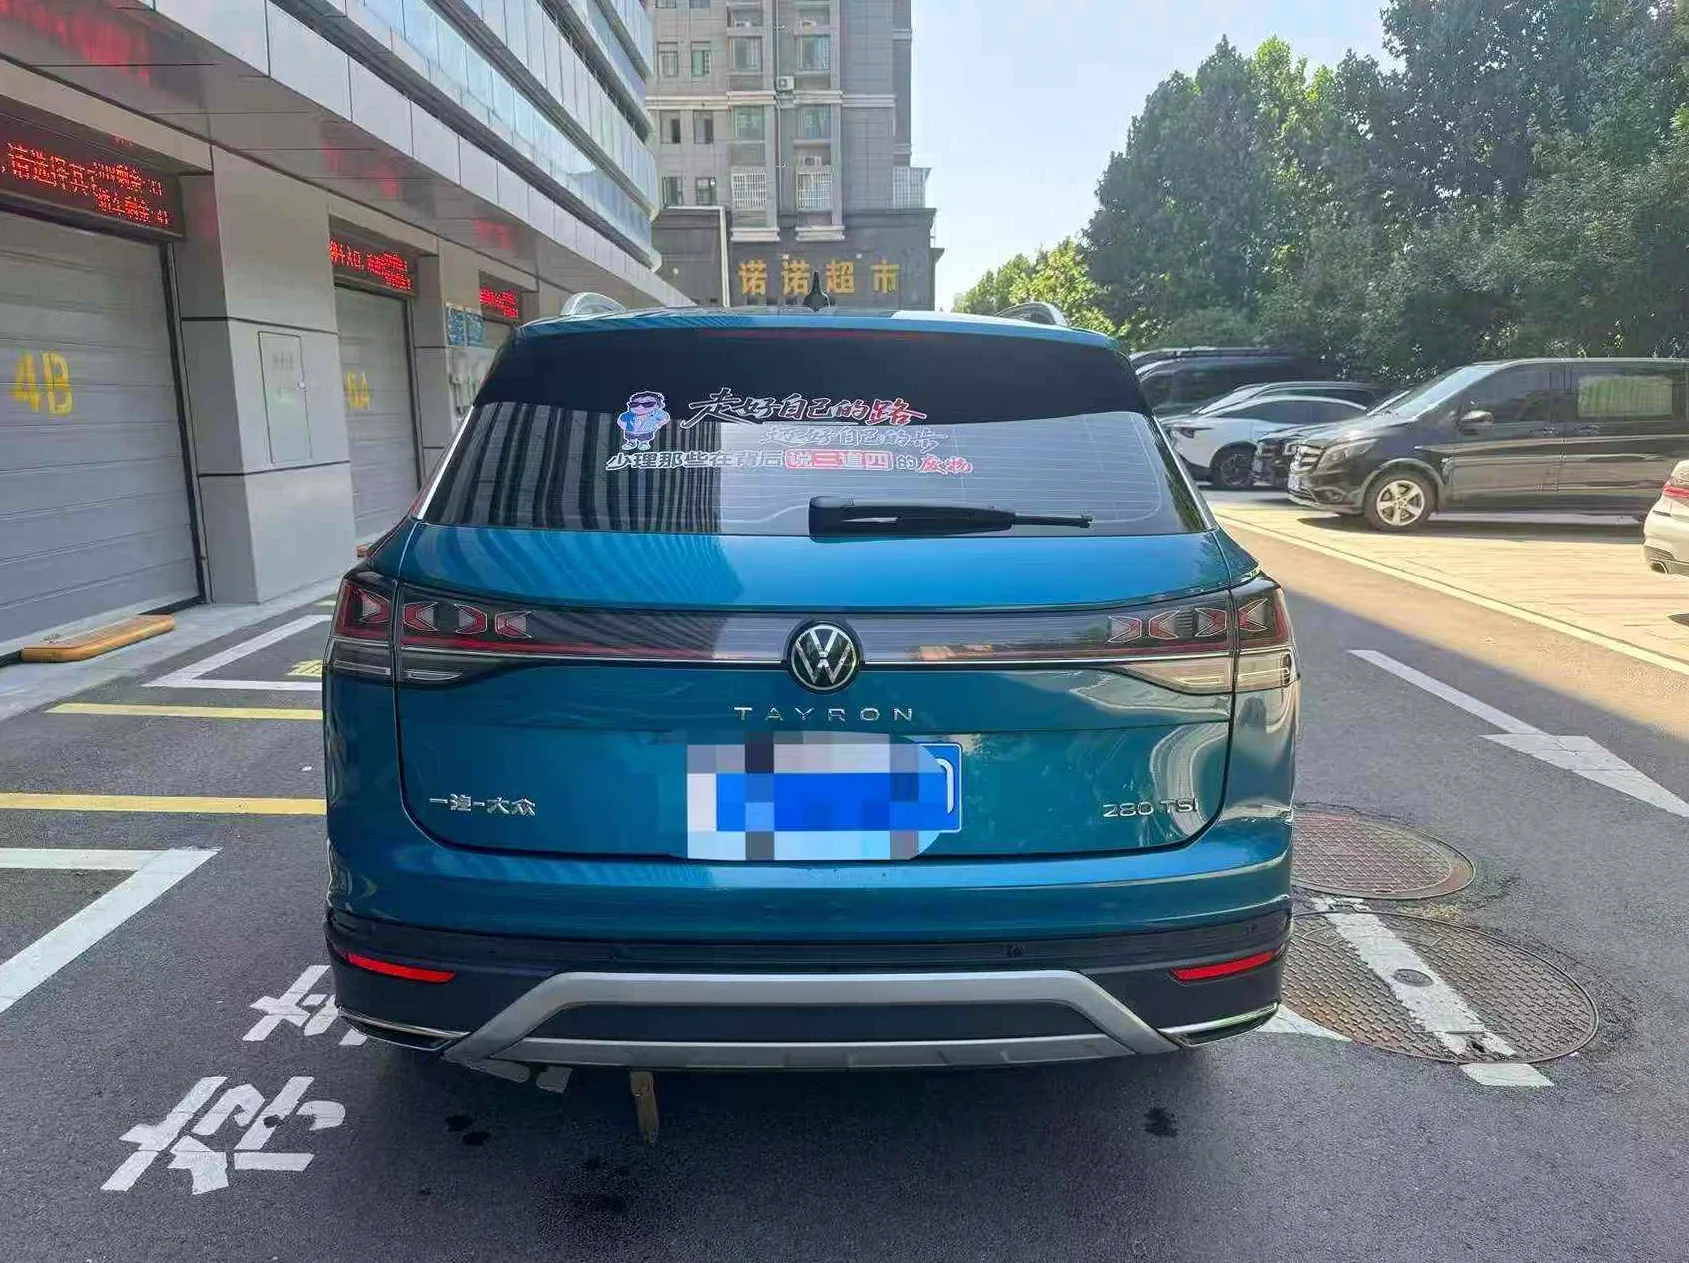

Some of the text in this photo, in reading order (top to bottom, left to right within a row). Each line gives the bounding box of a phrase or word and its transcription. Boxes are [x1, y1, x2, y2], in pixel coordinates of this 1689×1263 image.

[738, 257, 900, 296] 诺诺超市
[14, 353, 73, 414] 4B
[680, 387, 928, 429] 走好自己的路
[733, 704, 913, 721] TAYRON
[1102, 798, 1199, 818] 280 TSI
